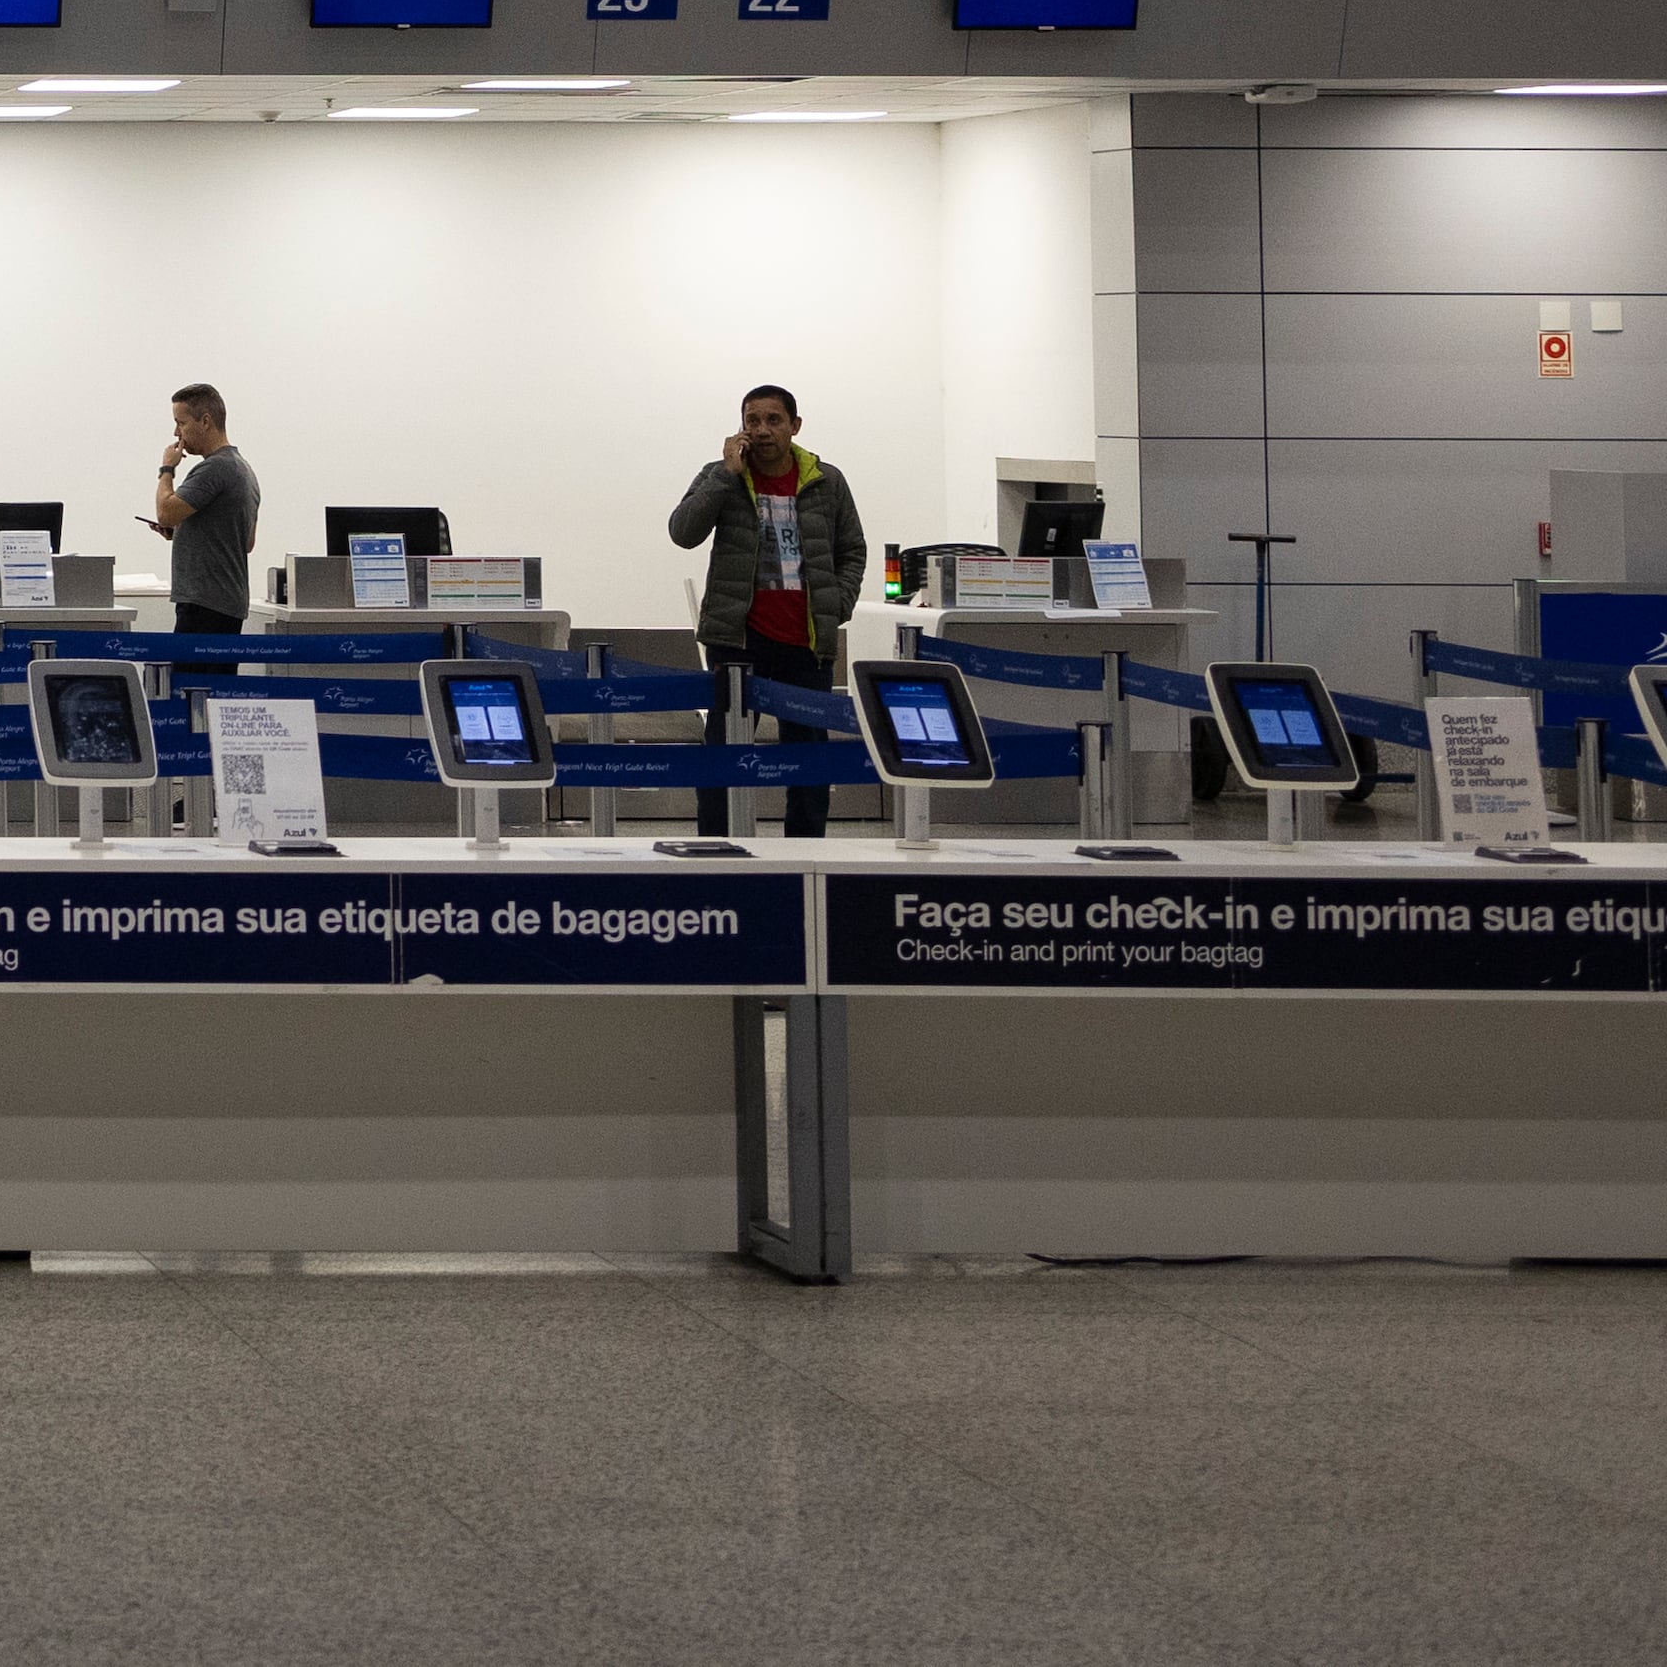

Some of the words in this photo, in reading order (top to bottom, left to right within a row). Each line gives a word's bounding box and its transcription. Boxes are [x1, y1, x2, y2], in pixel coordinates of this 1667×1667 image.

[1442, 714, 1477, 724] Quem
[1443, 725, 1493, 735] check-in
[1445, 735, 1510, 748] antecipado
[1451, 777, 1466, 787] de
[1468, 776, 1528, 788] embarque
[26, 906, 51, 933] e
[62, 898, 225, 941] imprima
[236, 907, 307, 934] sua
[318, 899, 480, 942] etiqueta
[490, 900, 541, 935] de
[552, 900, 739, 944] bagagem
